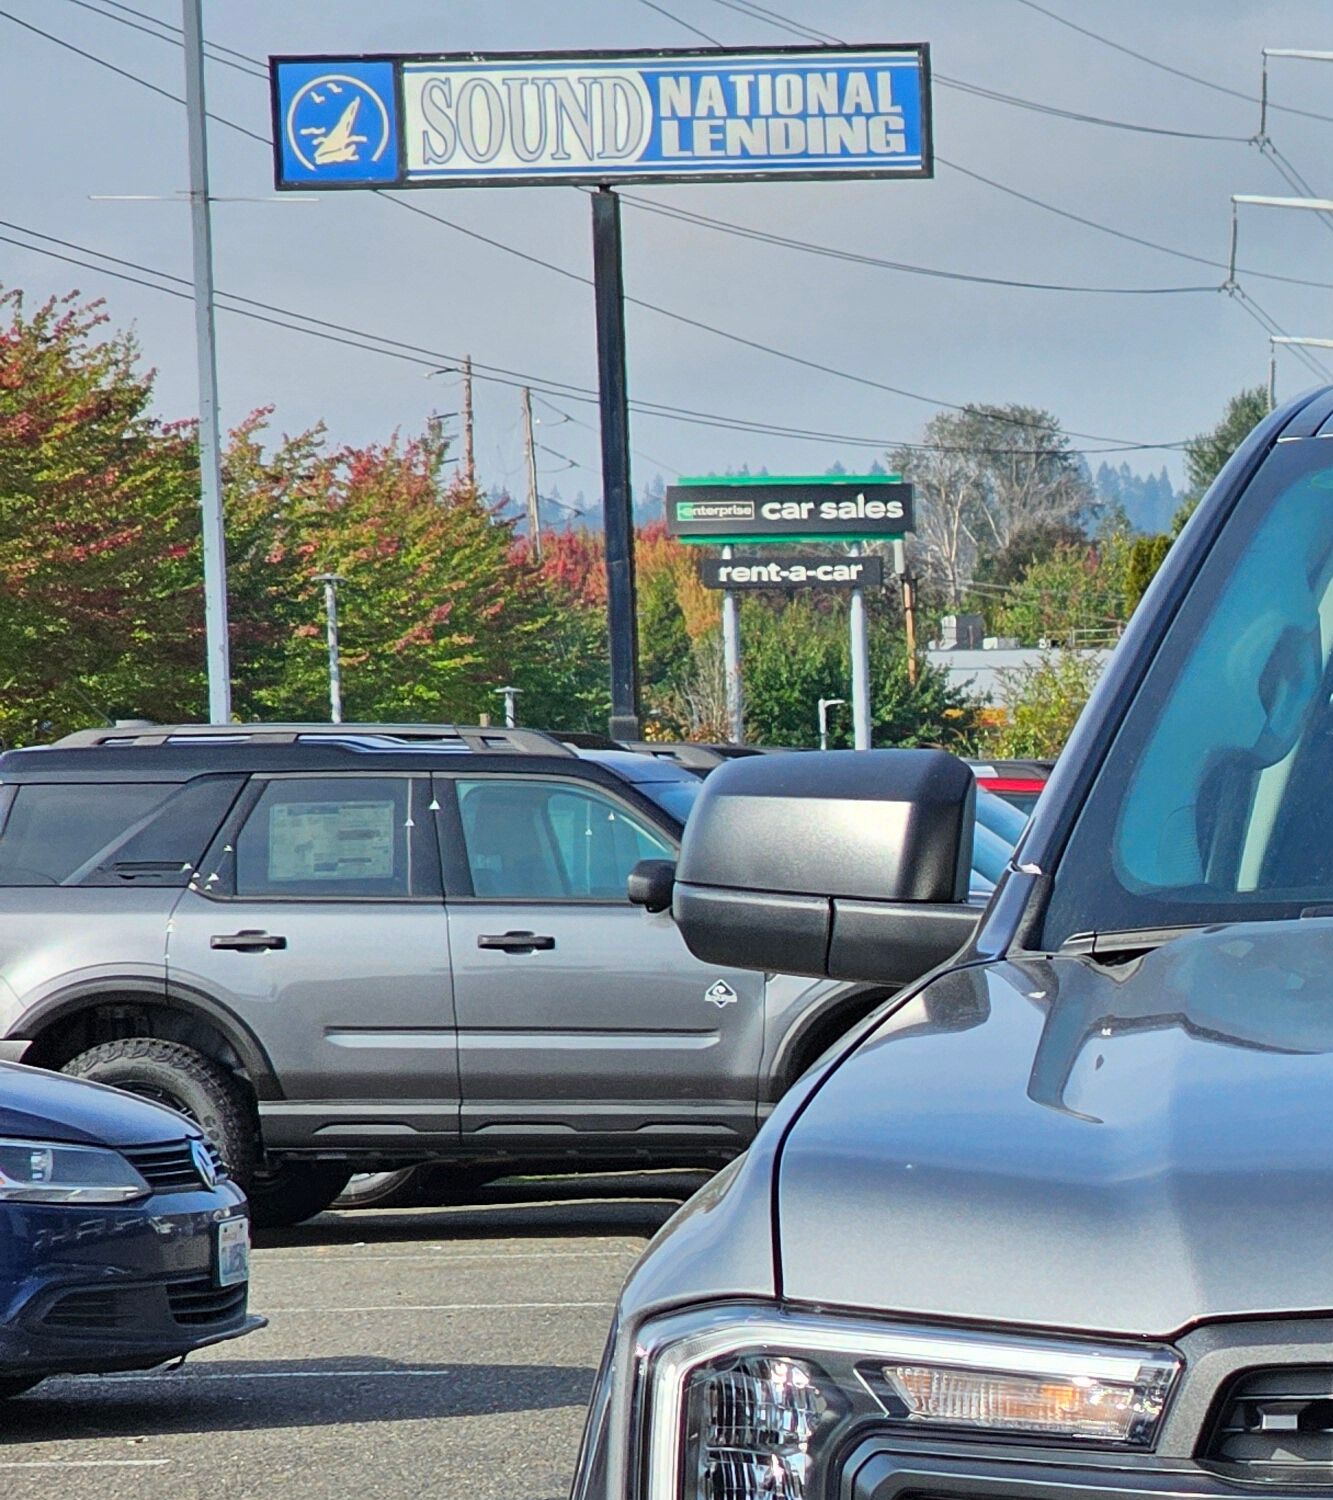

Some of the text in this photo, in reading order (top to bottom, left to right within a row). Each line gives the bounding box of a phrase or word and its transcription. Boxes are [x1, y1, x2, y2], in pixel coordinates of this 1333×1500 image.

[659, 71, 903, 117] NATIONAL
[420, 75, 645, 165] SOUND
[660, 116, 906, 158] LENDING
[680, 493, 904, 520] enterprise car sales
[718, 562, 863, 582] rent-a-car
